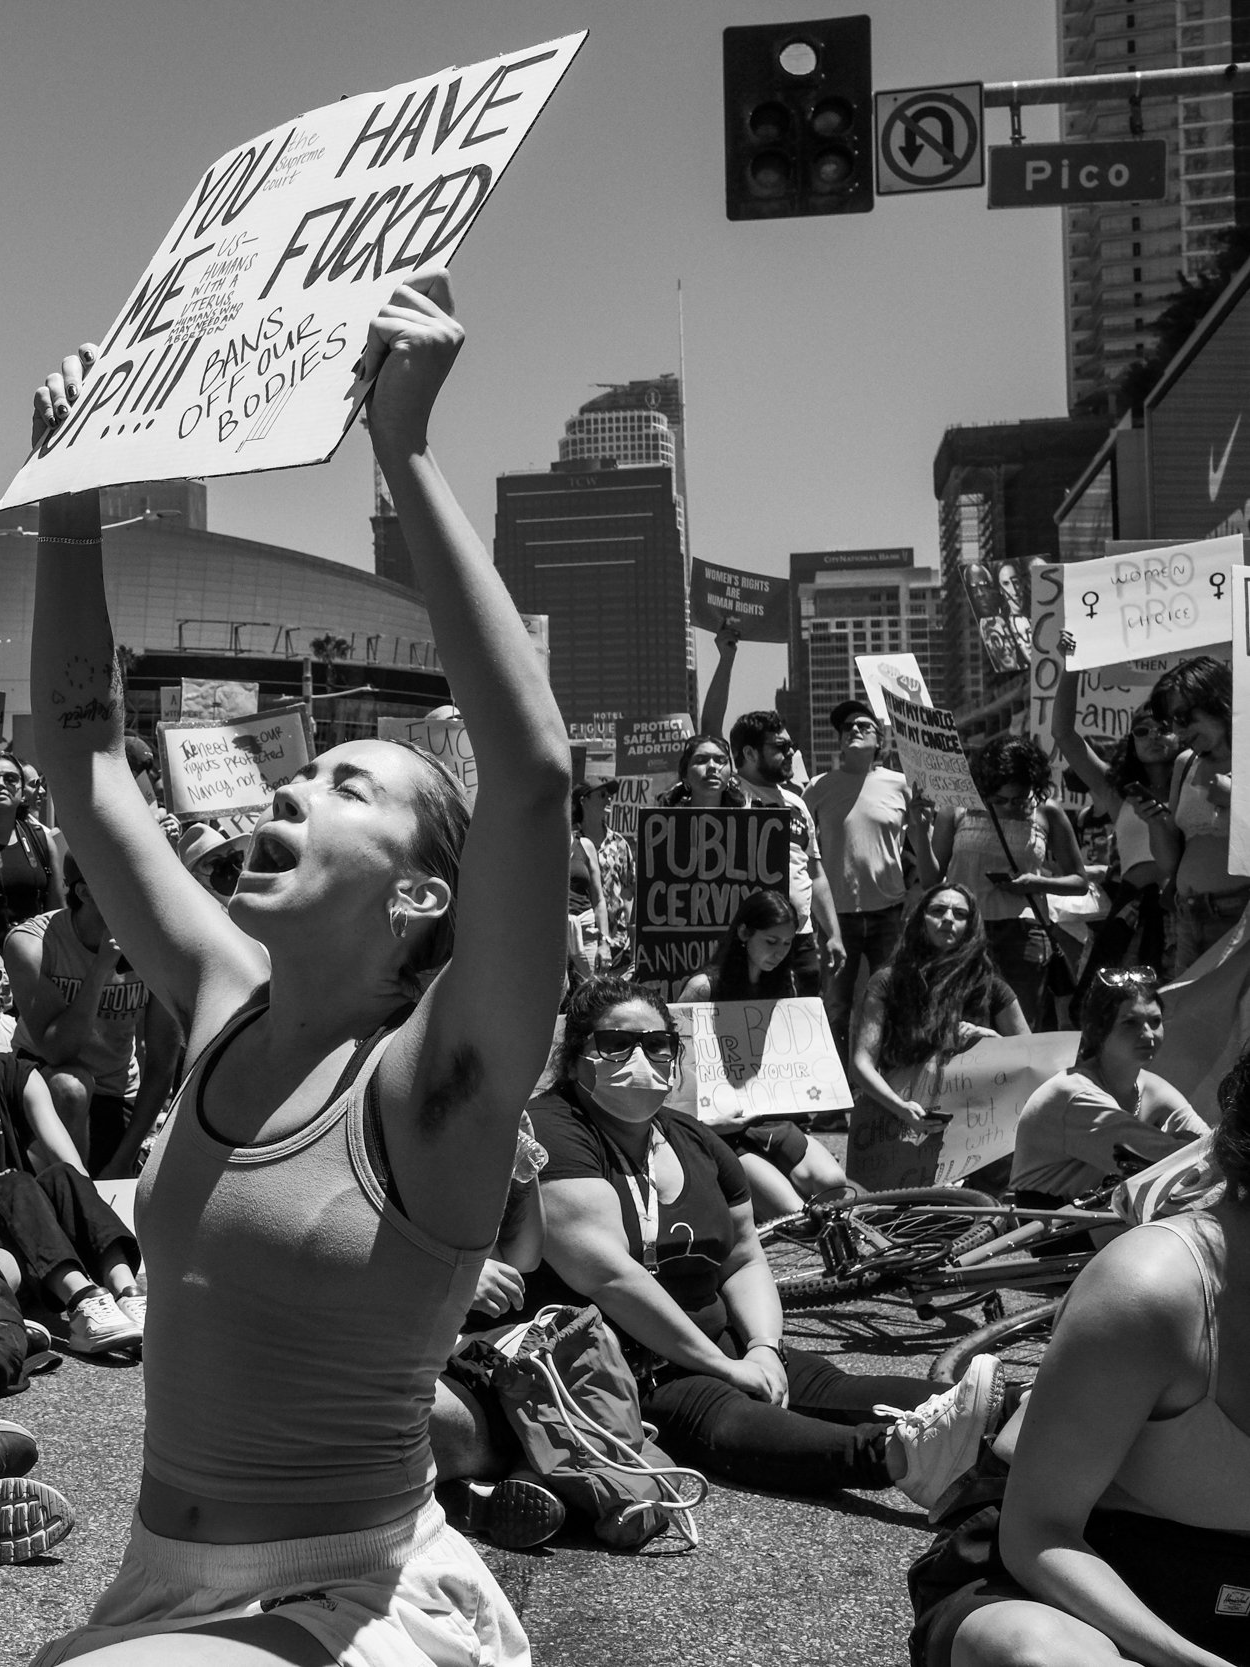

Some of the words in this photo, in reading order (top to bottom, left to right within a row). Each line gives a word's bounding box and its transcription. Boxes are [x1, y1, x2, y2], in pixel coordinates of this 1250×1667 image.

[170, 127, 296, 253] YOU
[335, 50, 558, 178] HAVE
[287, 130, 320, 151] the
[263, 172, 301, 191] court
[1025, 159, 1130, 191] Pico
[100, 243, 215, 358] ME
[257, 163, 492, 301] FUCKED
[200, 253, 259, 283] HUMANS
[191, 278, 227, 299] WITH
[229, 274, 239, 289] A
[174, 308, 220, 328] HUMANS
[220, 302, 244, 318] WHO
[169, 323, 196, 338] MAY
[199, 306, 285, 395] BANS
[178, 371, 247, 440] OFF
[256, 311, 323, 376] OUR
[217, 322, 348, 443] BODIES
[705, 567, 739, 586] WOMEN'S
[742, 576, 770, 592] RIGHTS
[1115, 552, 1195, 599] PRO
[707, 592, 733, 611] HUMAN
[735, 601, 764, 616] RIGHTS
[726, 586, 741, 600] ARE
[1120, 592, 1199, 648] PRO
[1127, 607, 1191, 629] CHOICE
[1134, 660, 1167, 671] THEN
[633, 719, 683, 733] PROTECT
[200, 737, 228, 758] need
[623, 734, 656, 745] SAFE,
[921, 729, 963, 754] CHOICE
[184, 758, 221, 781] rights
[224, 745, 284, 774] protected
[236, 772, 256, 789] not
[645, 813, 784, 885] PUBLIC
[744, 1003, 829, 1059] BODY
[700, 1063, 745, 1083] NOT
[751, 1062, 810, 1081] YOUR
[994, 1070, 1007, 1086] a
[966, 1097, 997, 1129] but
